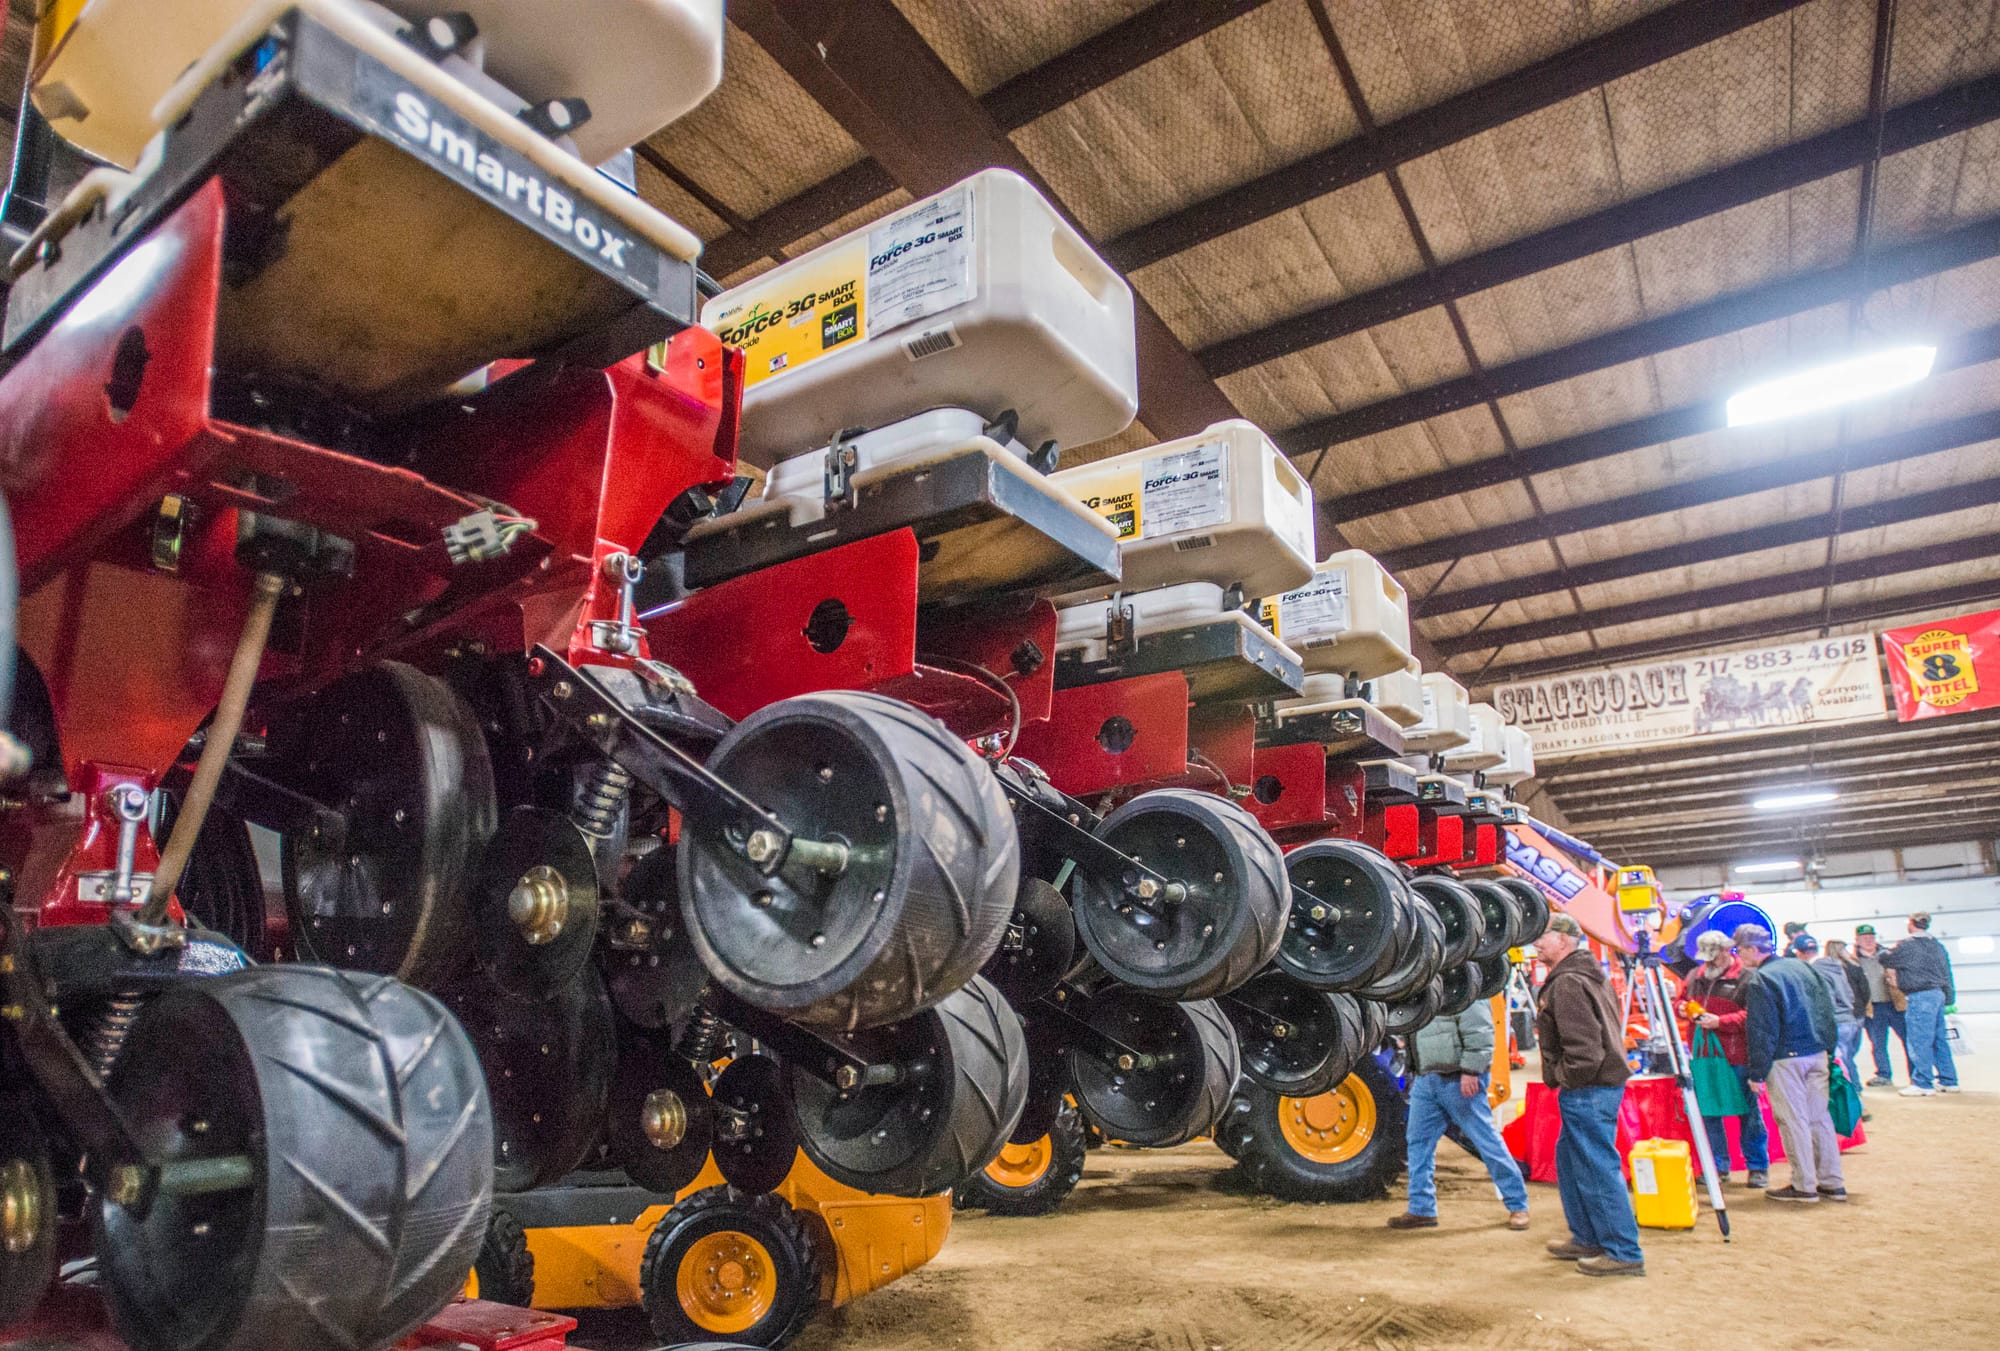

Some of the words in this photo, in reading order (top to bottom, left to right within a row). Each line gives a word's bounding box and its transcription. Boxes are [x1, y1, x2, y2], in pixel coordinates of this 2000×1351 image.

[393, 91, 627, 268] SmartBox
[948, 232, 964, 243] BOX
[870, 240, 913, 270] Force
[914, 232, 936, 248] 3G
[937, 226, 964, 240] SMART
[832, 289, 857, 308] BOX
[719, 308, 784, 346] Force
[785, 292, 816, 320] 3G
[818, 279, 857, 305] SMART
[824, 317, 855, 337] SMART
[836, 326, 855, 340] BOX
[1182, 471, 1199, 482] 3G
[1102, 493, 1134, 506] SMART
[1114, 500, 1133, 511] BOX
[1281, 590, 1311, 602] Force
[1694, 638, 1867, 678] 217-883-4618
[1910, 639, 1961, 658] SUPER
[1922, 653, 1962, 682] 8
[1500, 664, 1690, 726] STAGECOACH
[1817, 682, 1870, 697] Carryout
[1817, 693, 1873, 707] Available
[1543, 723, 1558, 734] AT
[1562, 711, 1643, 732] GORDYVILLE
[1532, 737, 1569, 751] URANT
[1581, 731, 1622, 745] SALOON
[1634, 726, 1660, 739] GIFT
[1663, 723, 1692, 736] SHOP
